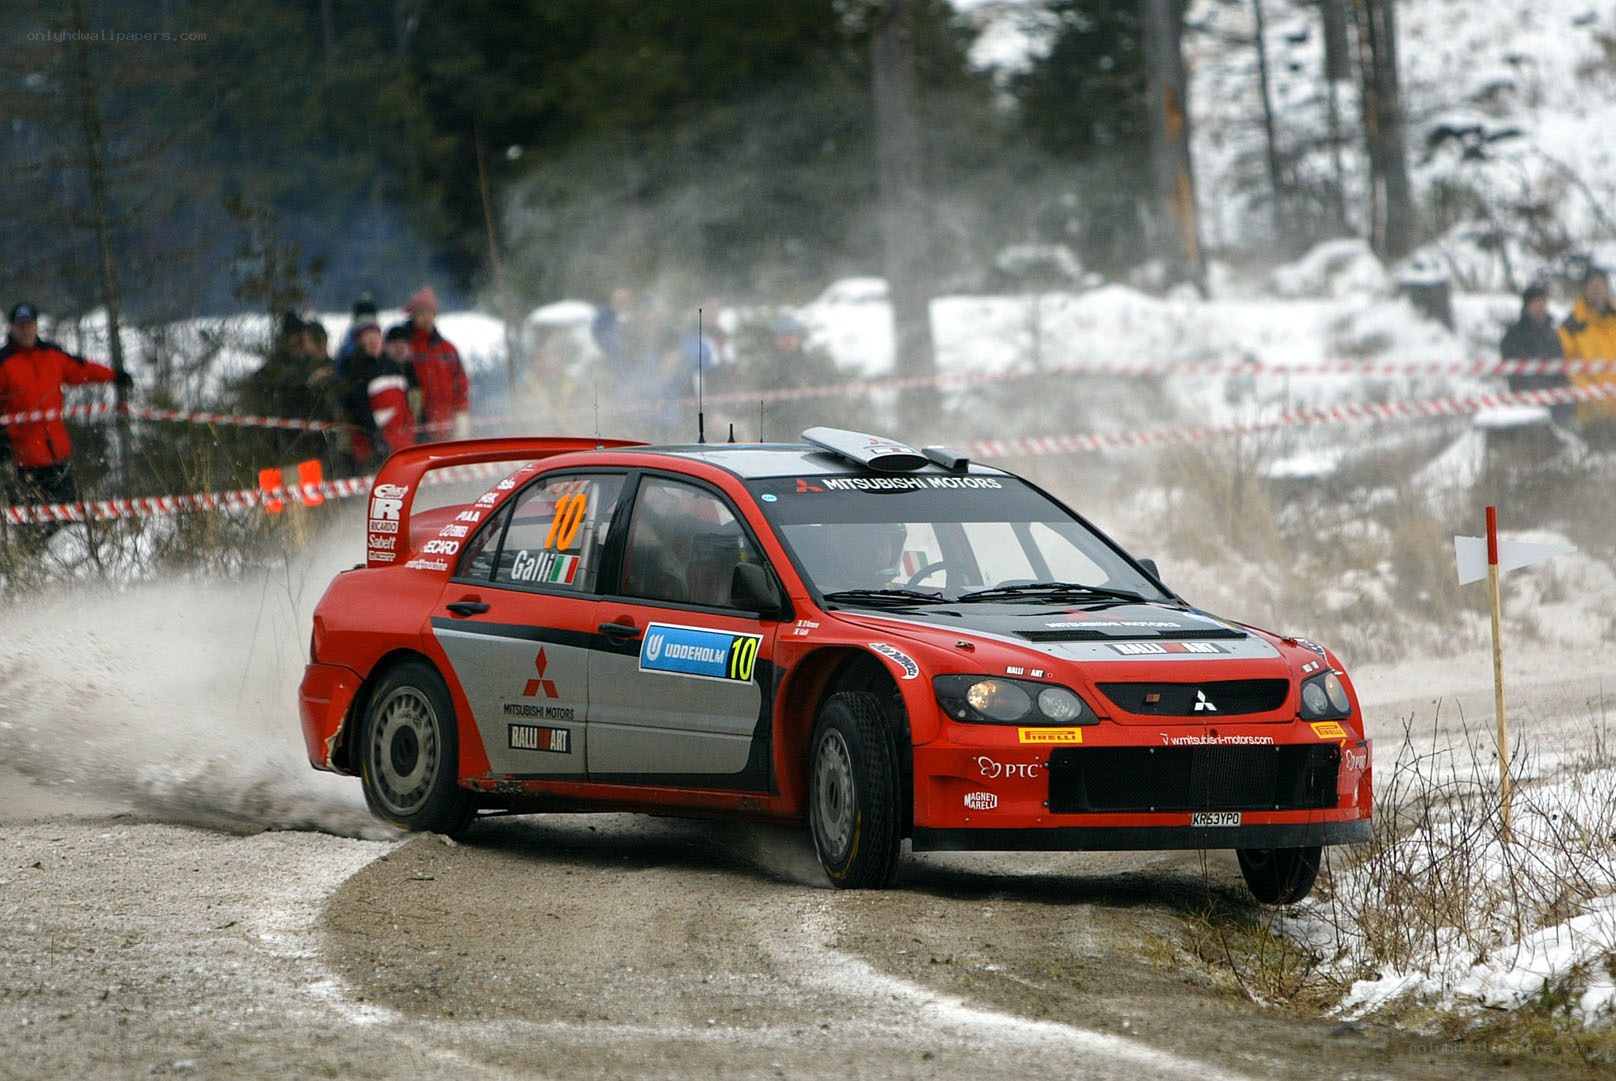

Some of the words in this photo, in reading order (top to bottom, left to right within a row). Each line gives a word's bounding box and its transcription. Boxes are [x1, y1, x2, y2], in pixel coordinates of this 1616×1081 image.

[822, 477, 927, 490] MITSUBISHI
[926, 477, 1002, 490] MOTORS
[370, 520, 397, 532] RICARDO
[544, 493, 586, 551] 10
[511, 550, 555, 582] Galli
[665, 643, 725, 664] UDDEHOLM
[731, 637, 757, 680] 10
[503, 703, 544, 718] MITSUBISHI
[545, 707, 574, 720] MOTORS
[1025, 731, 1077, 740] PIRELLI
[1005, 763, 1039, 778] PTC
